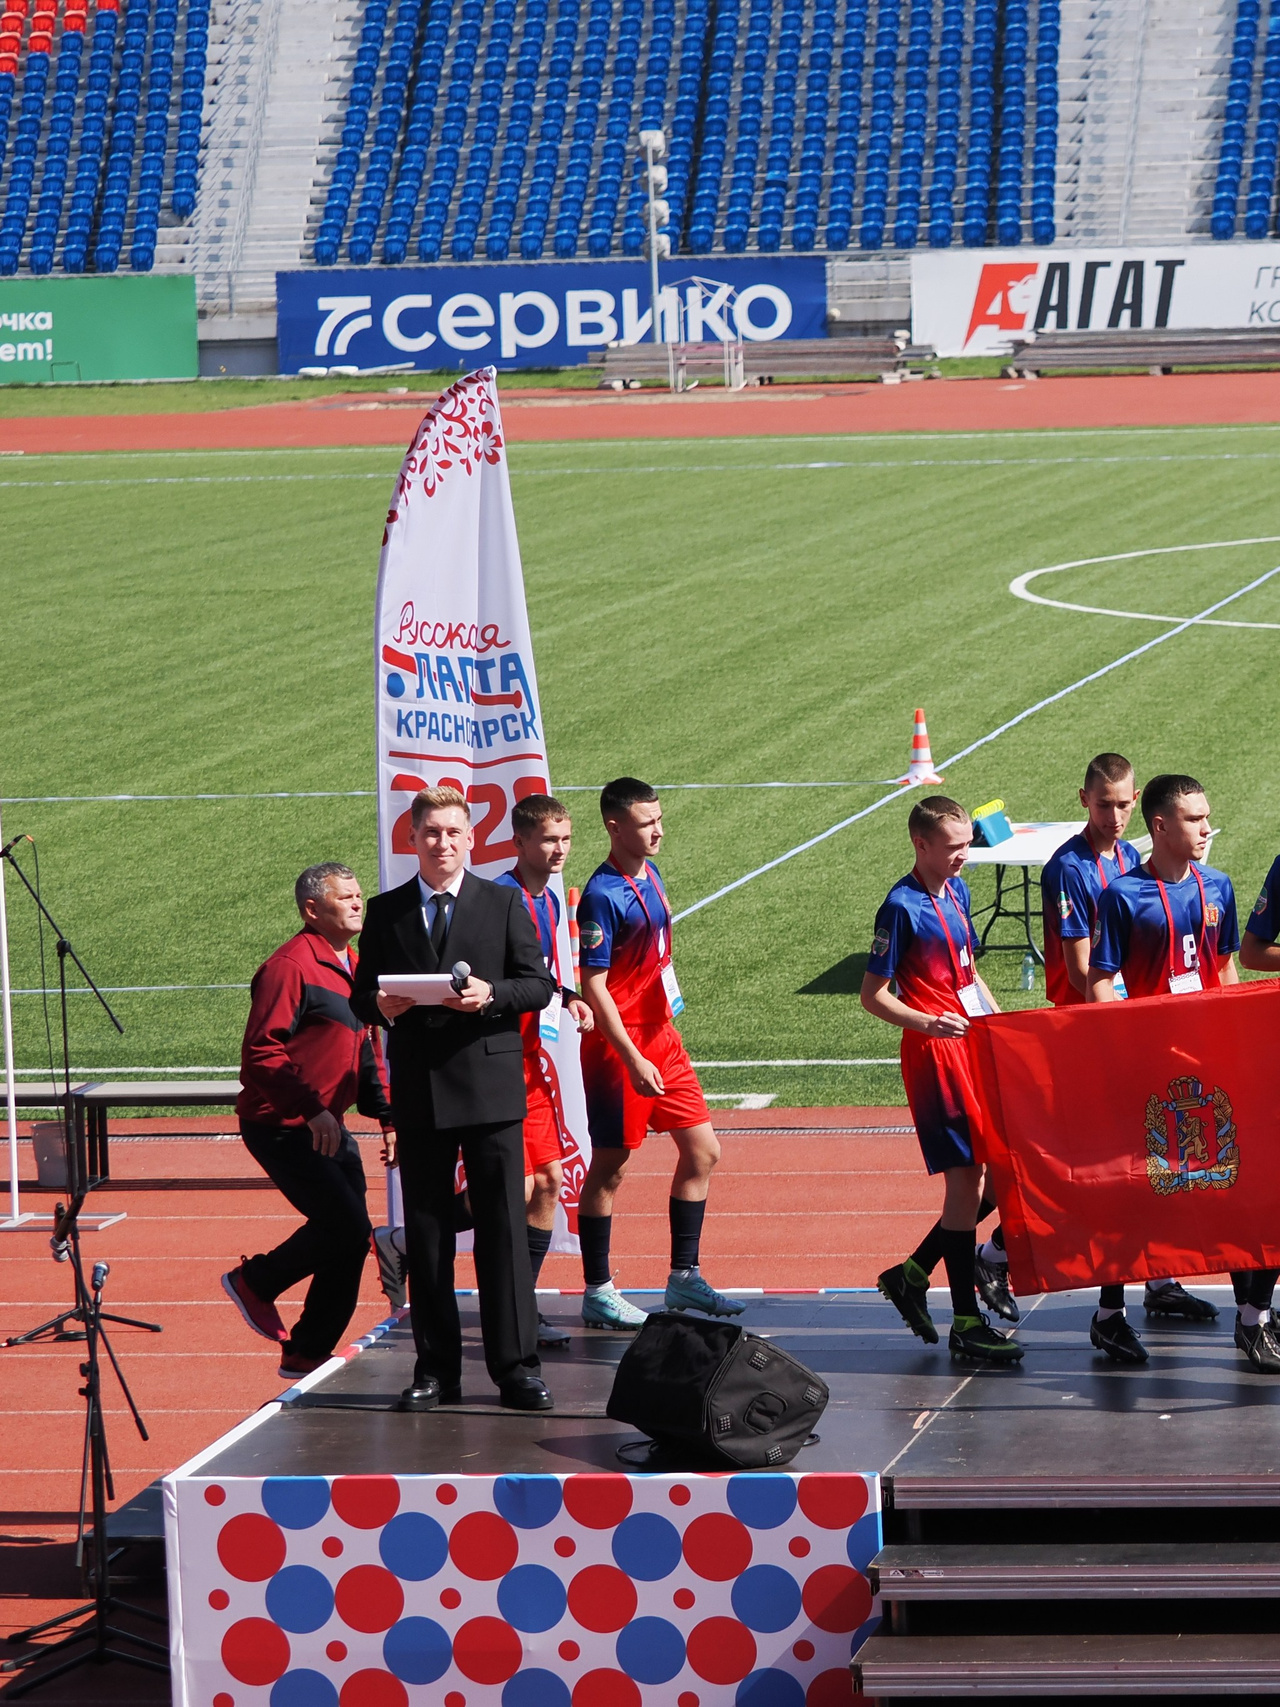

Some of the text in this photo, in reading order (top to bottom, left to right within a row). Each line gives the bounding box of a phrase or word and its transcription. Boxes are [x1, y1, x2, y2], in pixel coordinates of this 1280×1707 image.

[0, 311, 53, 331] чка
[382, 284, 792, 358] сервико
[1034, 260, 1185, 329] АГАТ
[393, 601, 511, 653] Русская
[416, 652, 535, 718] ЛАПТА
[397, 709, 539, 749] КРАСНОЯРСК
